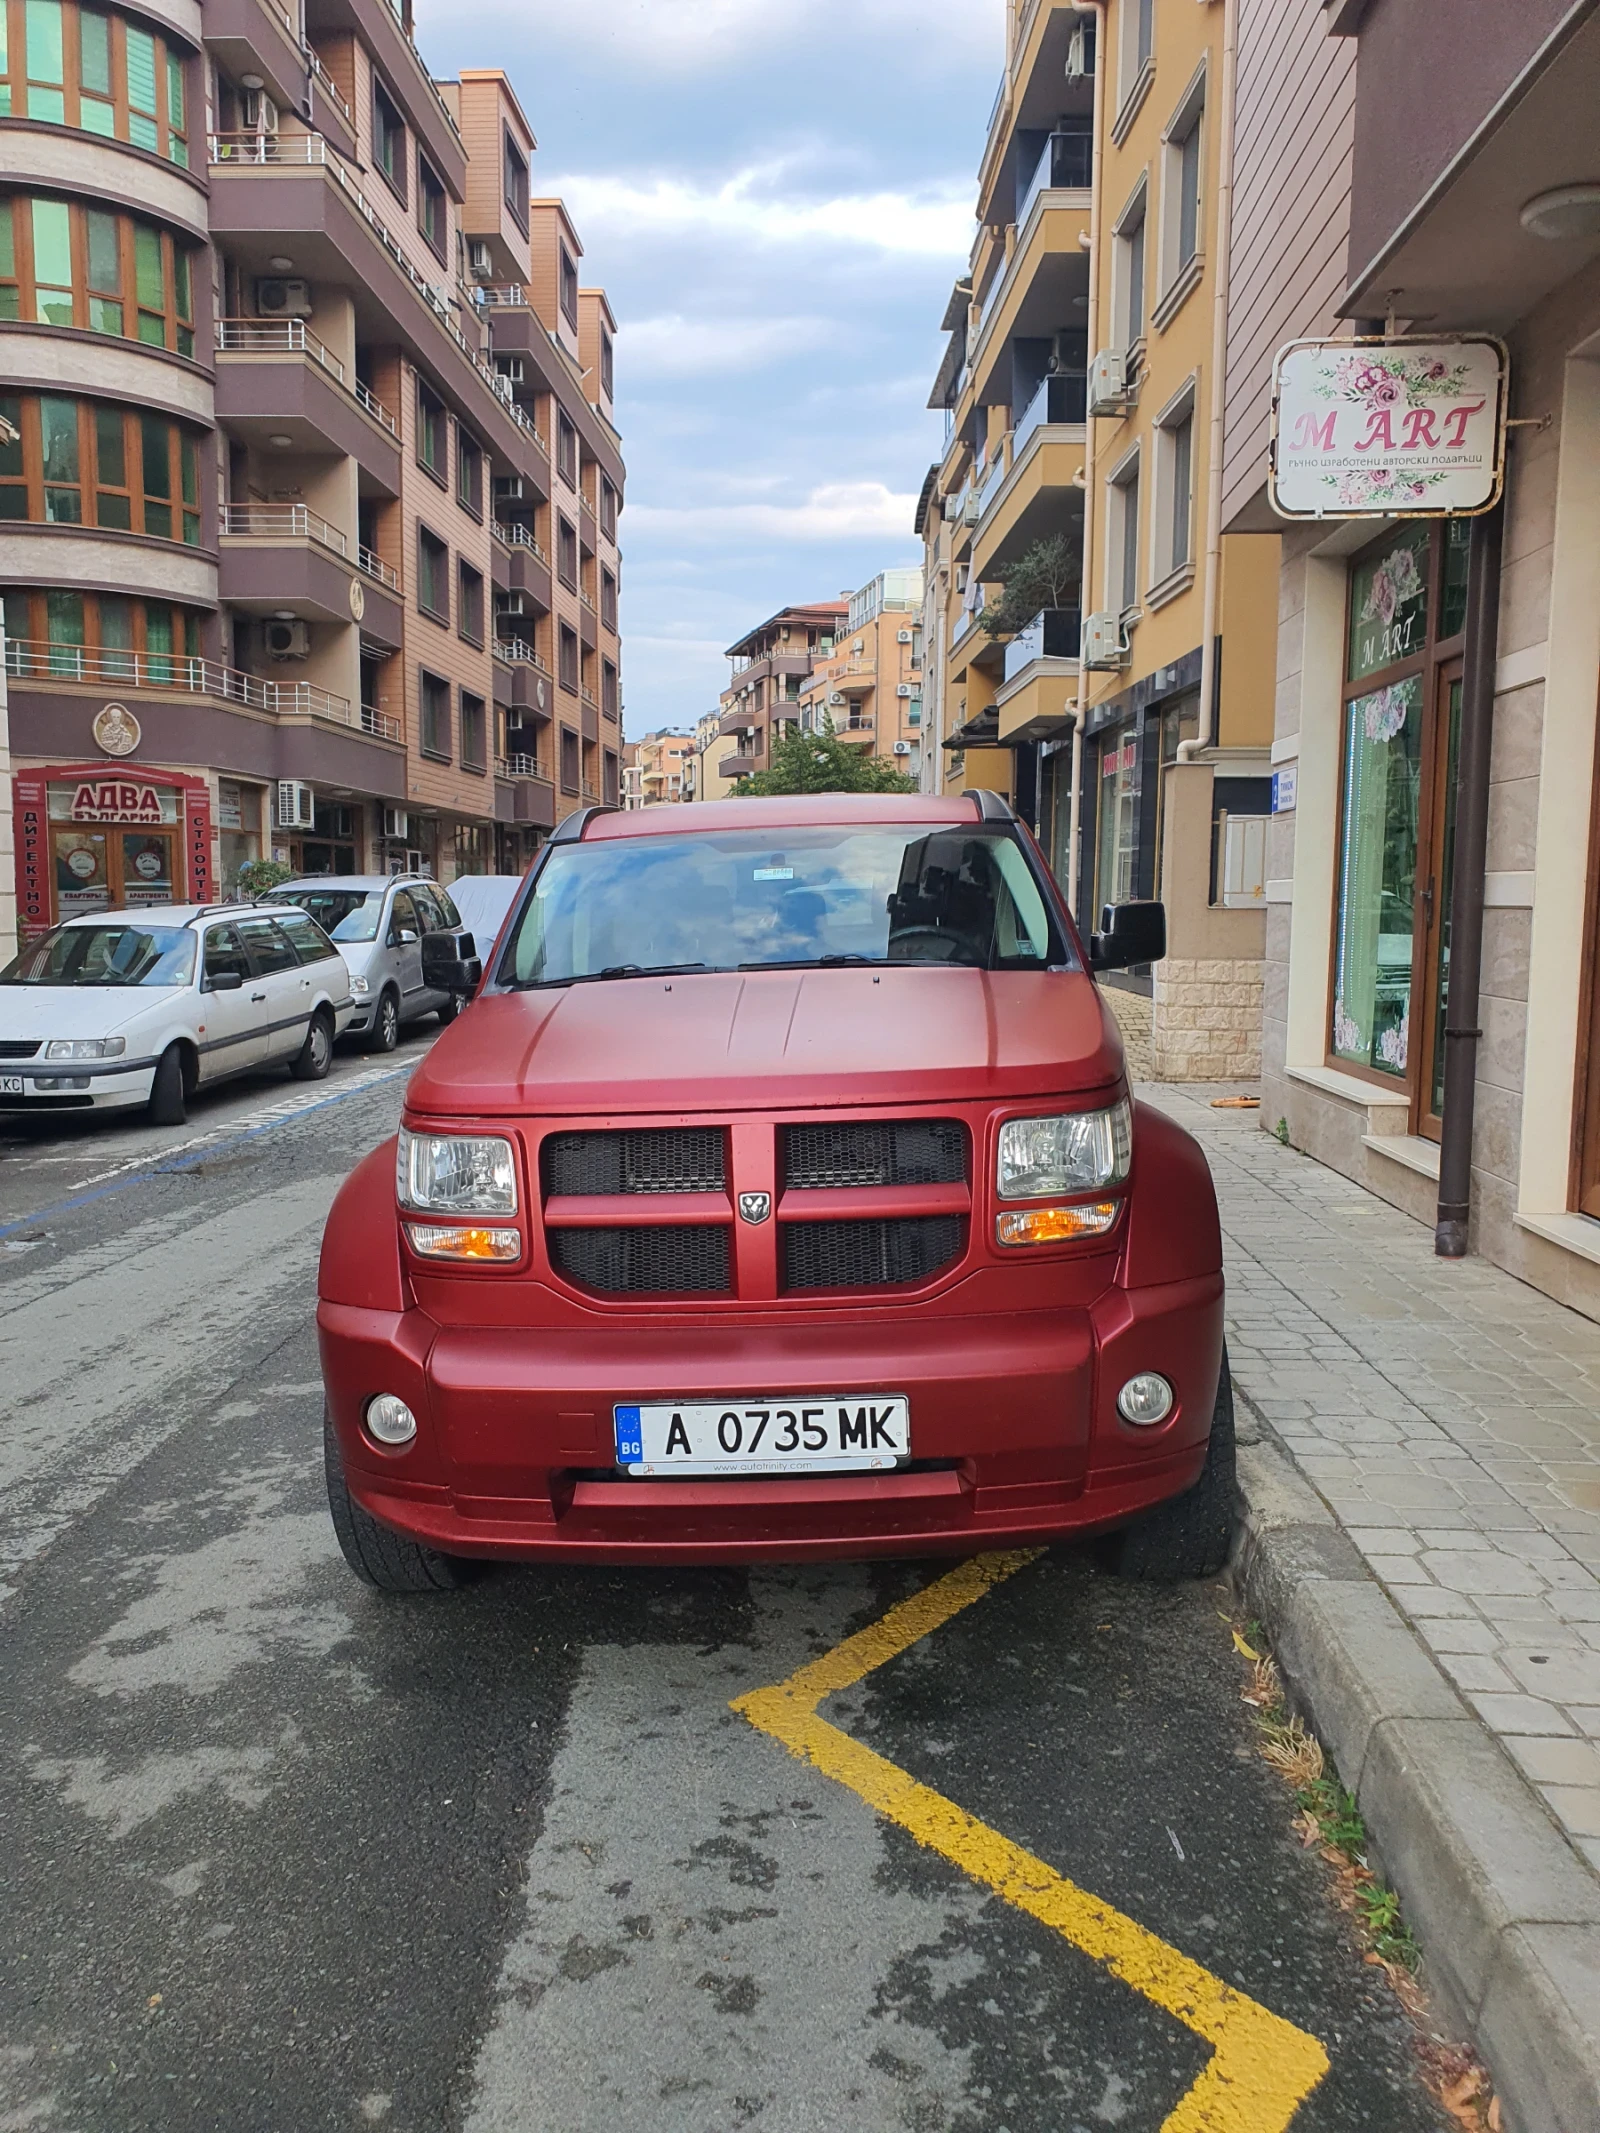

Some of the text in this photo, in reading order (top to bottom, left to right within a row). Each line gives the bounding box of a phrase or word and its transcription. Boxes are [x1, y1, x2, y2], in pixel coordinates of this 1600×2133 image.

[1288, 399, 1487, 453] M ART
[1320, 456, 1381, 468] изработени
[1382, 455, 1429, 467] авторски
[1431, 454, 1483, 466] подаръци
[1361, 610, 1416, 669] M ART
[73, 784, 161, 812] АДВА
[74, 812, 161, 823] БЪЛГАРИЯ
[23, 811, 40, 915] ДИРЕКТНО
[3, 1078, 20, 1091] KC
[665, 1405, 898, 1455] A 0735 MK
[621, 1442, 641, 1455] BG
[713, 1462, 813, 1472] www.autotrinity.com
